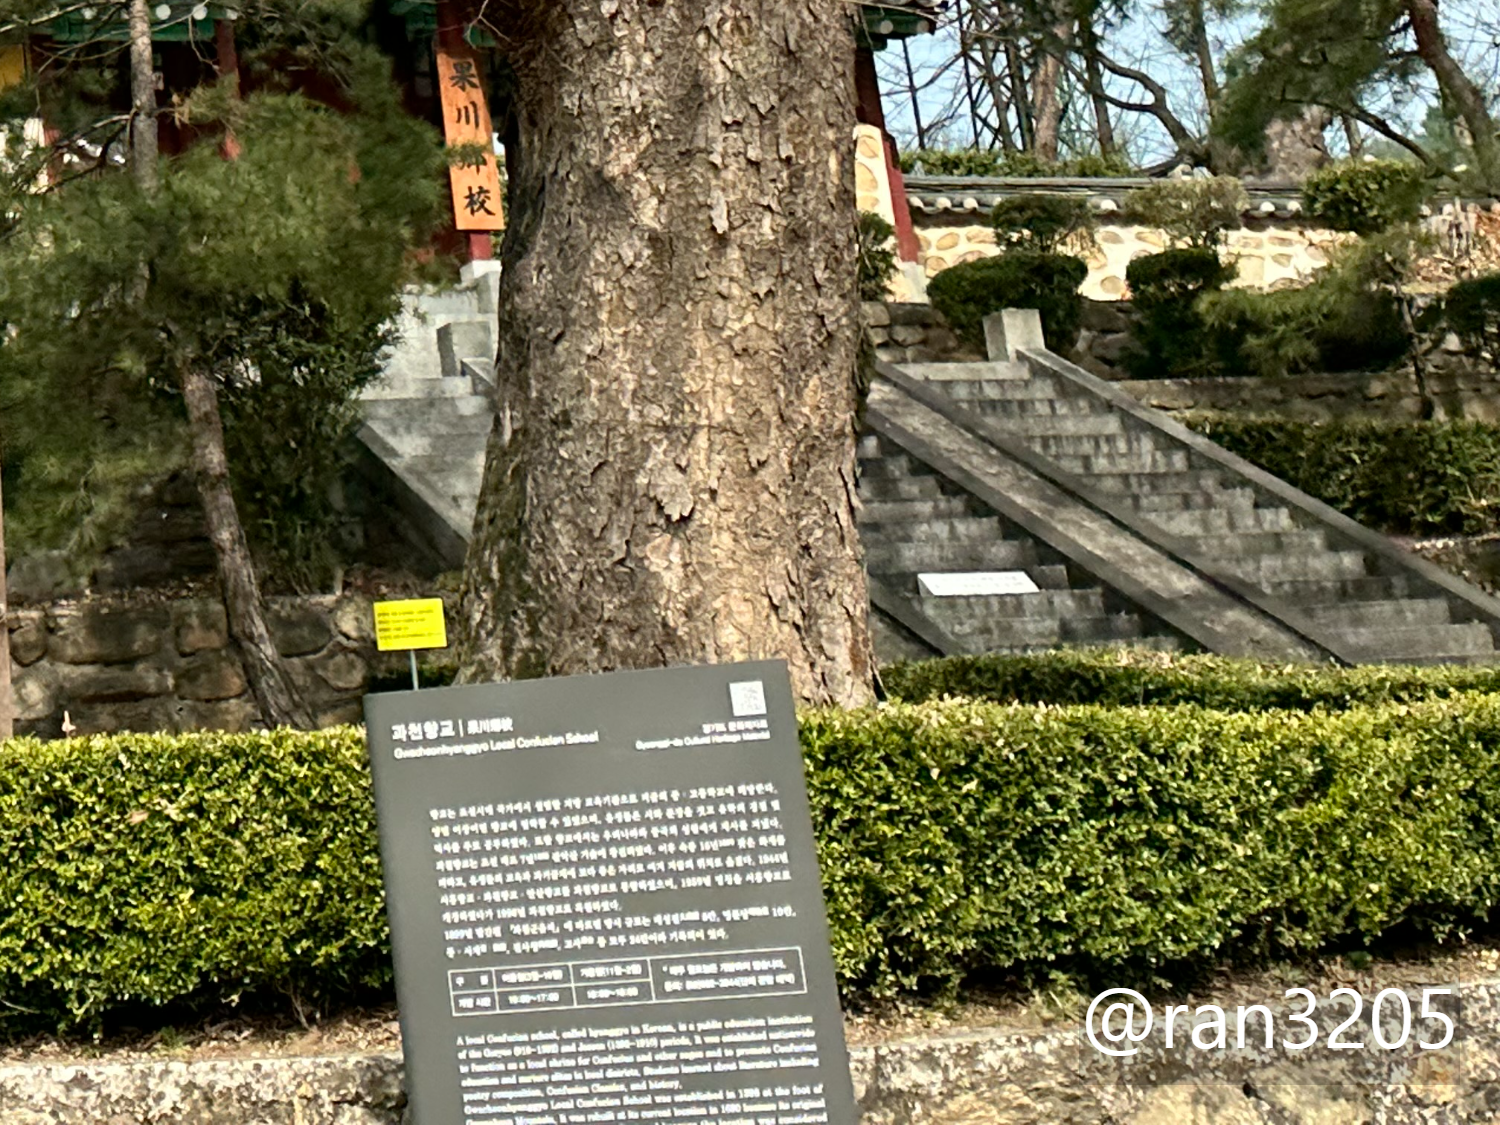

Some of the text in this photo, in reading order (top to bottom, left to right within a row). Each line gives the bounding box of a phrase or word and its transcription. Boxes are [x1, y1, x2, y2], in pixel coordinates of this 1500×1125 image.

[390, 719, 455, 742] 과천향교
[489, 738, 516, 751] Local
[515, 733, 565, 748] Confucian
[564, 730, 599, 744] School
